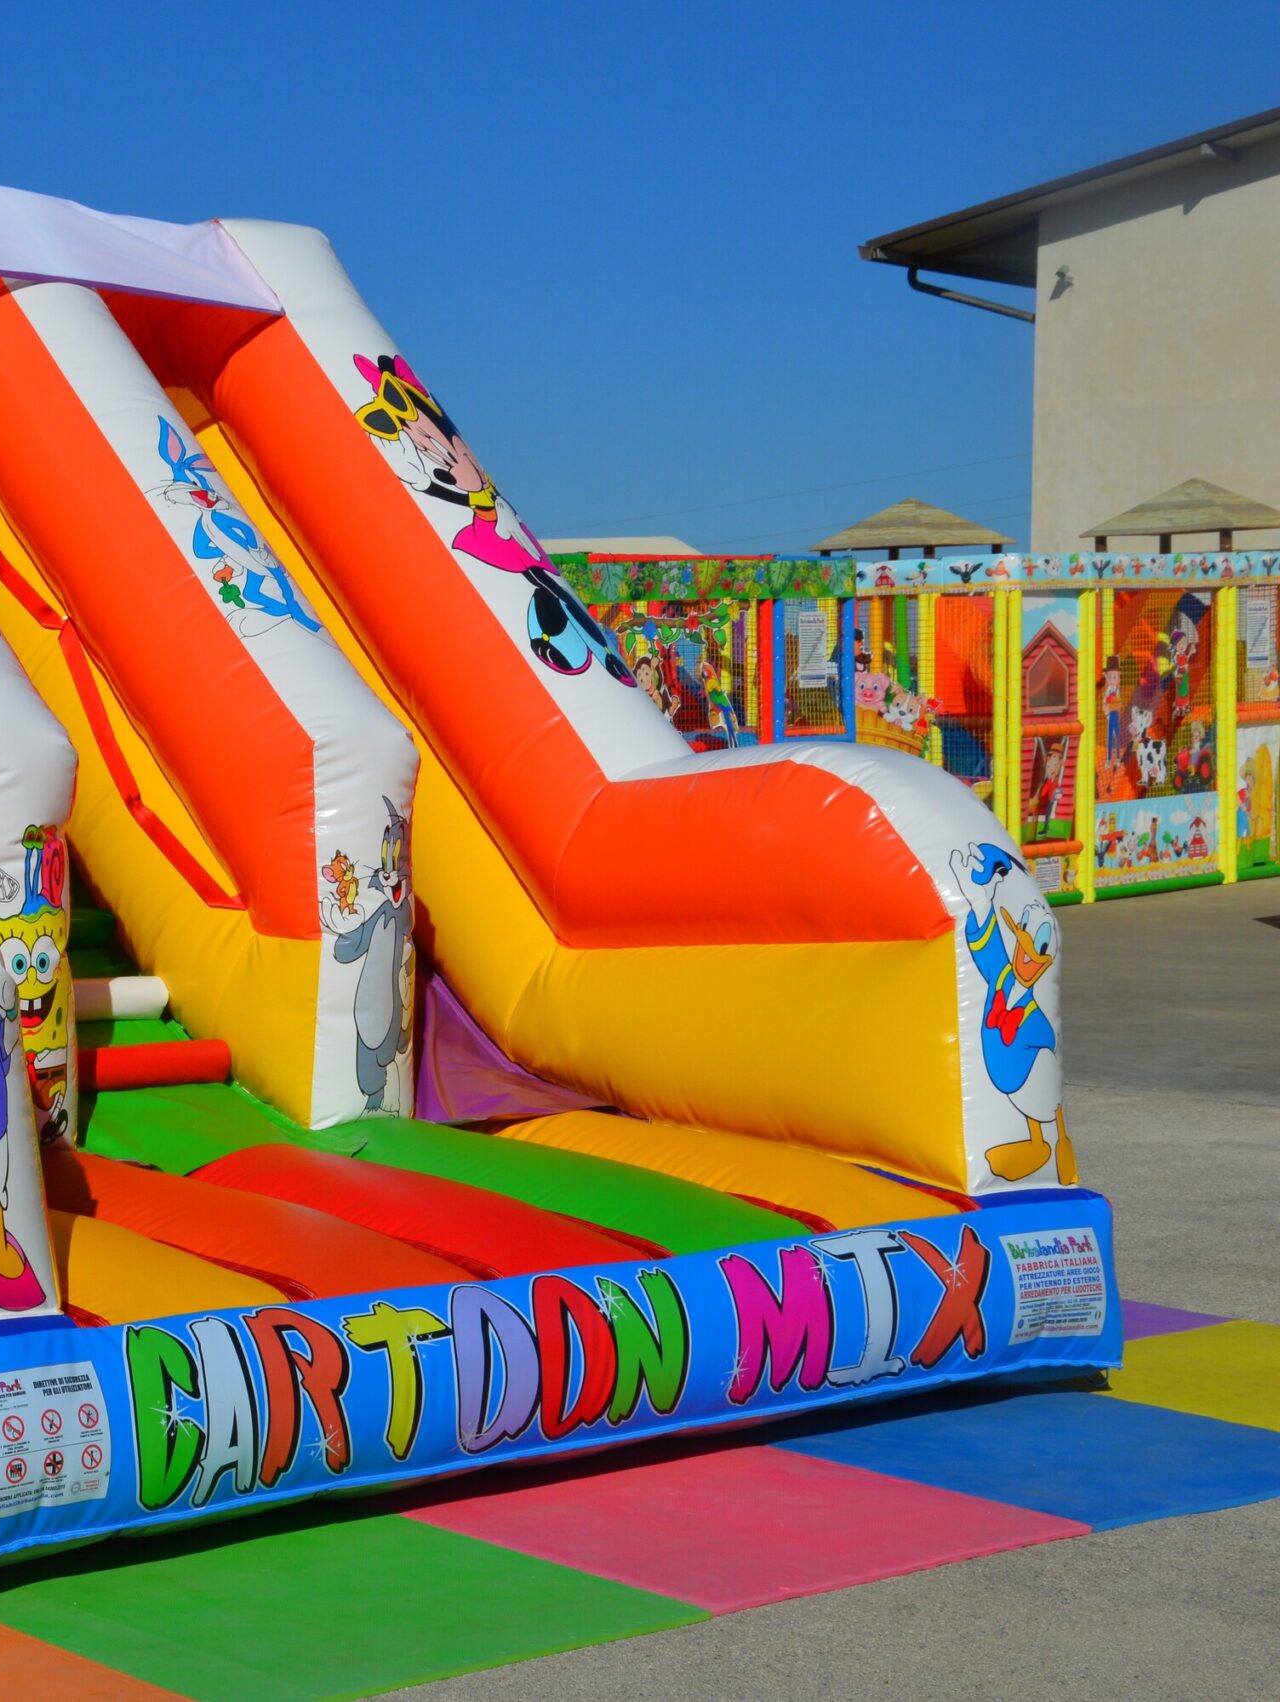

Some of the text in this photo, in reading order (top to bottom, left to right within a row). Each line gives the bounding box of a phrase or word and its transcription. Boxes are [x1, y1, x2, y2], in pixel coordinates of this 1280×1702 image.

[1067, 1235, 1093, 1254] Park
[1016, 1257, 1098, 1273] FABBRICA ITALIANA
[1018, 1266, 1100, 1281] ATTREZZATURE AREE GIOCO
[1020, 1275, 1100, 1290] PER INTERNO ED ESTERNO
[1060, 1286, 1072, 1294] PER
[126, 1224, 992, 1511] CARTOON MIX
[32, 1374, 91, 1389] DIRETTIVE DI SICUREZZA
[42, 1382, 94, 1397] PER GLI UTILIZZATORI
